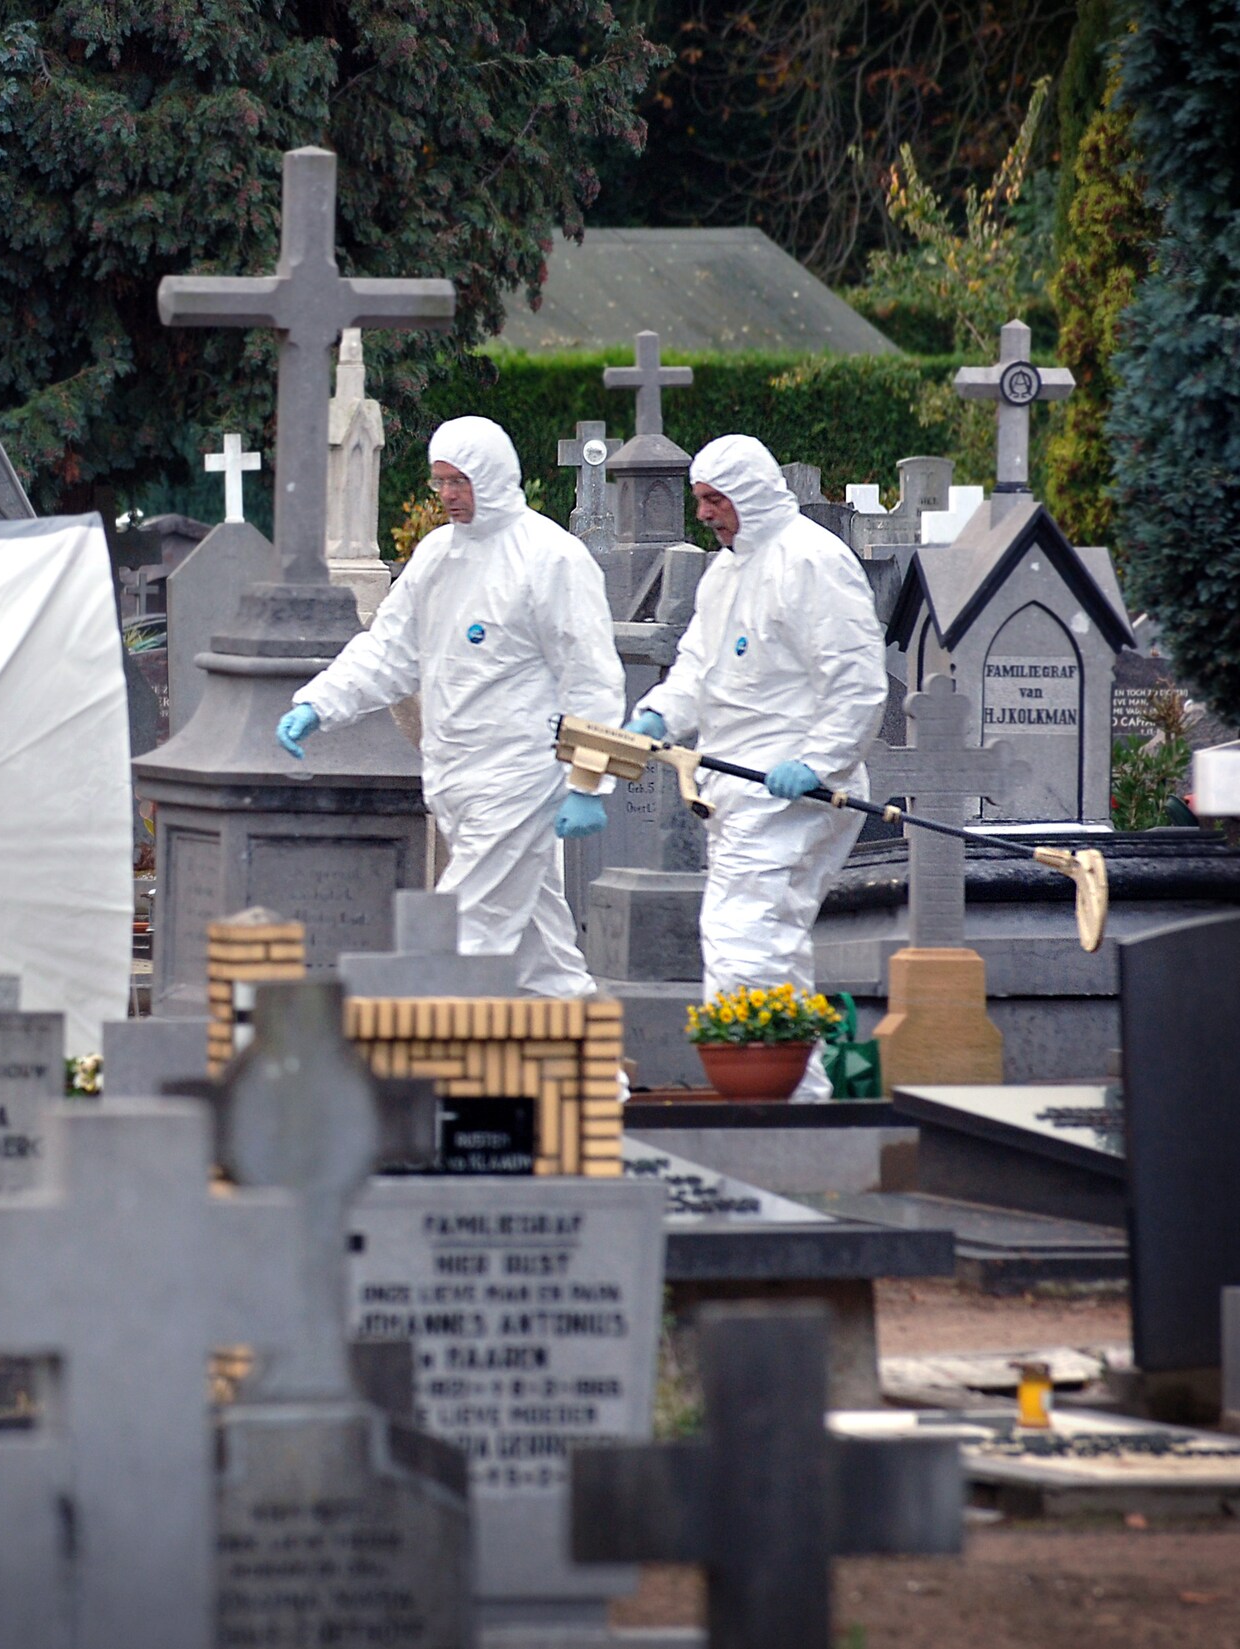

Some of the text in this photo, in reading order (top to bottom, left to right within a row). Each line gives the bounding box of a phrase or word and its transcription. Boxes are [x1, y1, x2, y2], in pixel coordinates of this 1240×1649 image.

[985, 664, 1077, 678] FAMILIEGRAF
[1018, 687, 1043, 699] van
[1127, 689, 1146, 697] TOCH
